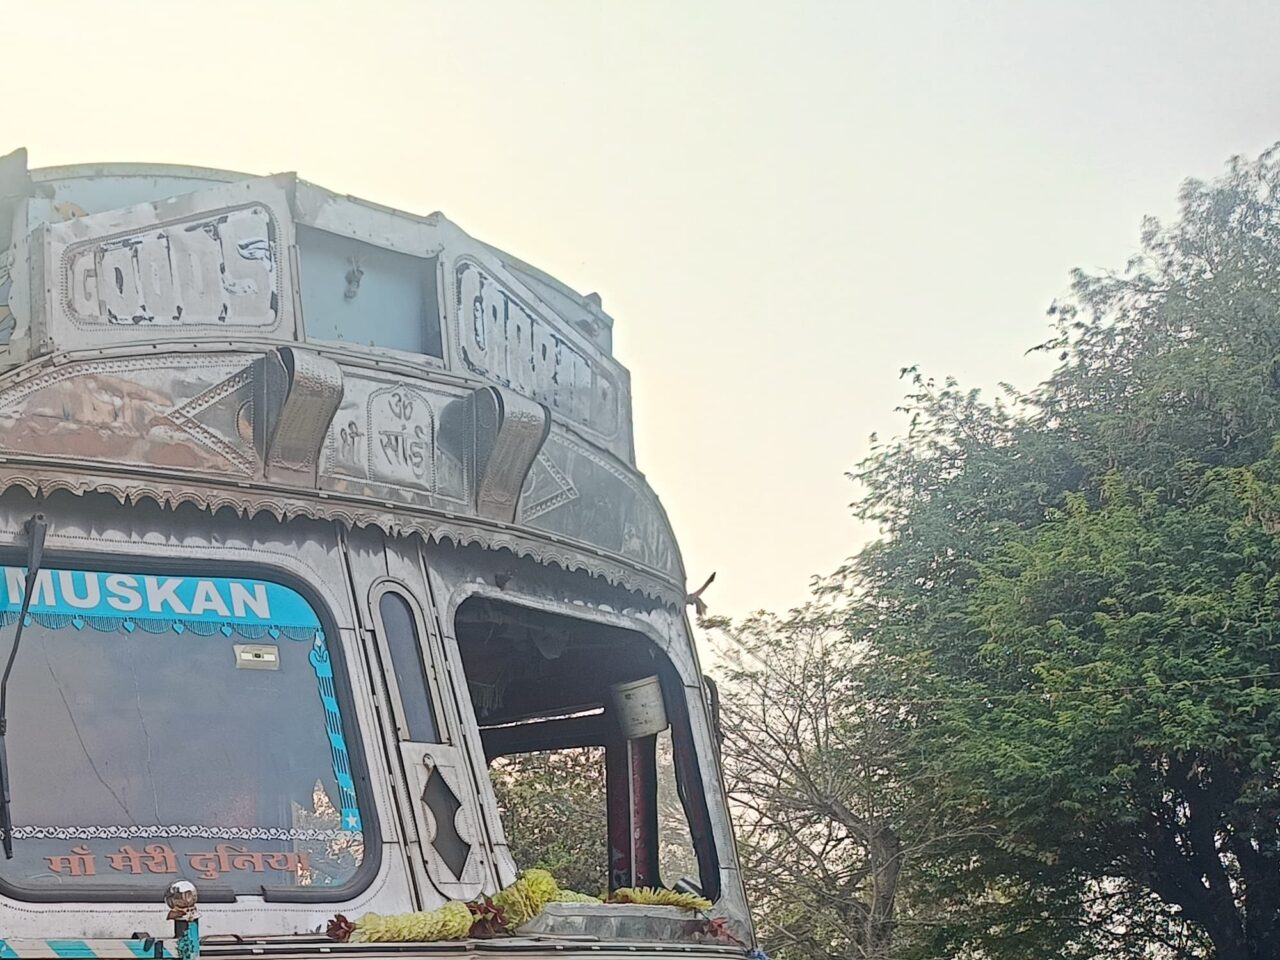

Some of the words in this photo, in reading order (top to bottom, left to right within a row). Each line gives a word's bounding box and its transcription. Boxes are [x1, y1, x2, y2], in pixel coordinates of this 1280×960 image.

[4, 567, 270, 619] MUSKAN
[43, 844, 96, 877] माँ
[185, 843, 311, 881] दुनिया
